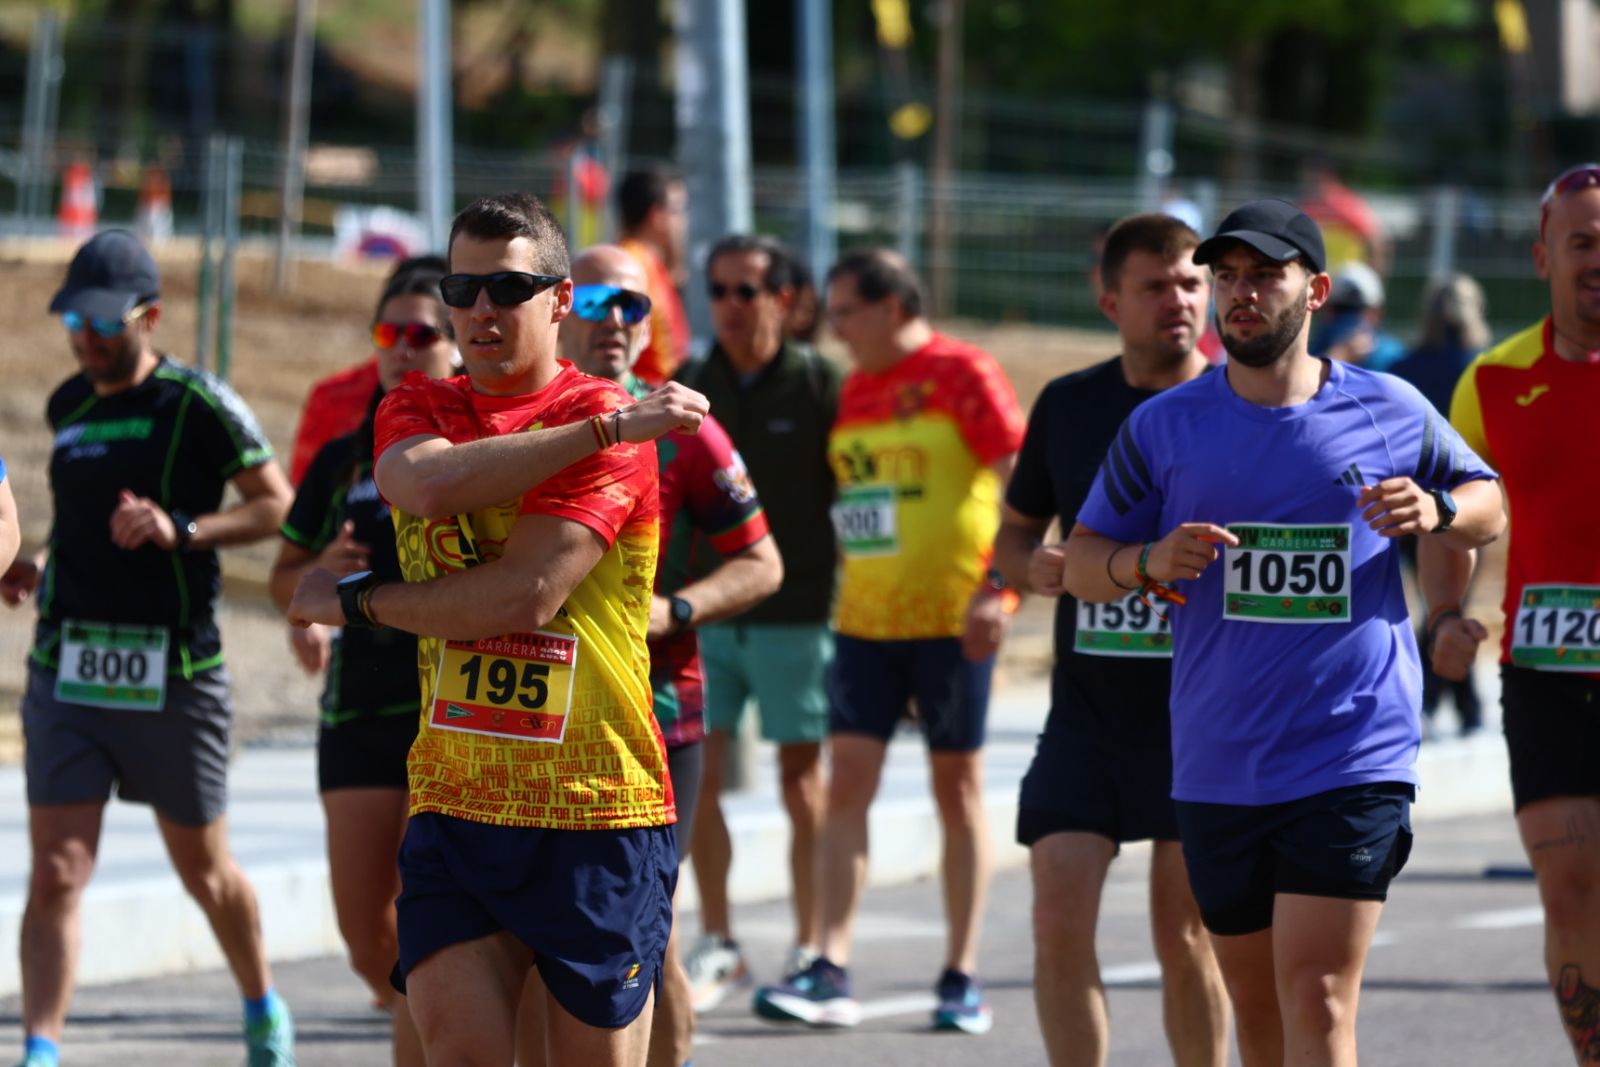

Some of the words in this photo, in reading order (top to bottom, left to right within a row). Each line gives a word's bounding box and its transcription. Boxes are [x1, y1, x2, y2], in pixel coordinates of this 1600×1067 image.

[1261, 536, 1317, 549] CARRERA
[1232, 551, 1345, 594] 1050
[1083, 594, 1169, 631] 1597
[1520, 609, 1600, 646] 1120
[478, 638, 537, 657] CARRERA
[78, 649, 147, 683] 800
[460, 655, 550, 709] 195
[474, 748, 492, 761] POR
[511, 747, 554, 762] TRABAJO
[559, 745, 565, 759] A
[512, 764, 532, 777] POR
[552, 759, 597, 775] TRABAJO
[601, 758, 608, 772] A
[511, 790, 549, 804] LEALTAD
[563, 791, 593, 805] VALOR
[598, 790, 617, 804] POR
[516, 803, 545, 818] VALOR
[549, 806, 570, 820] POR
